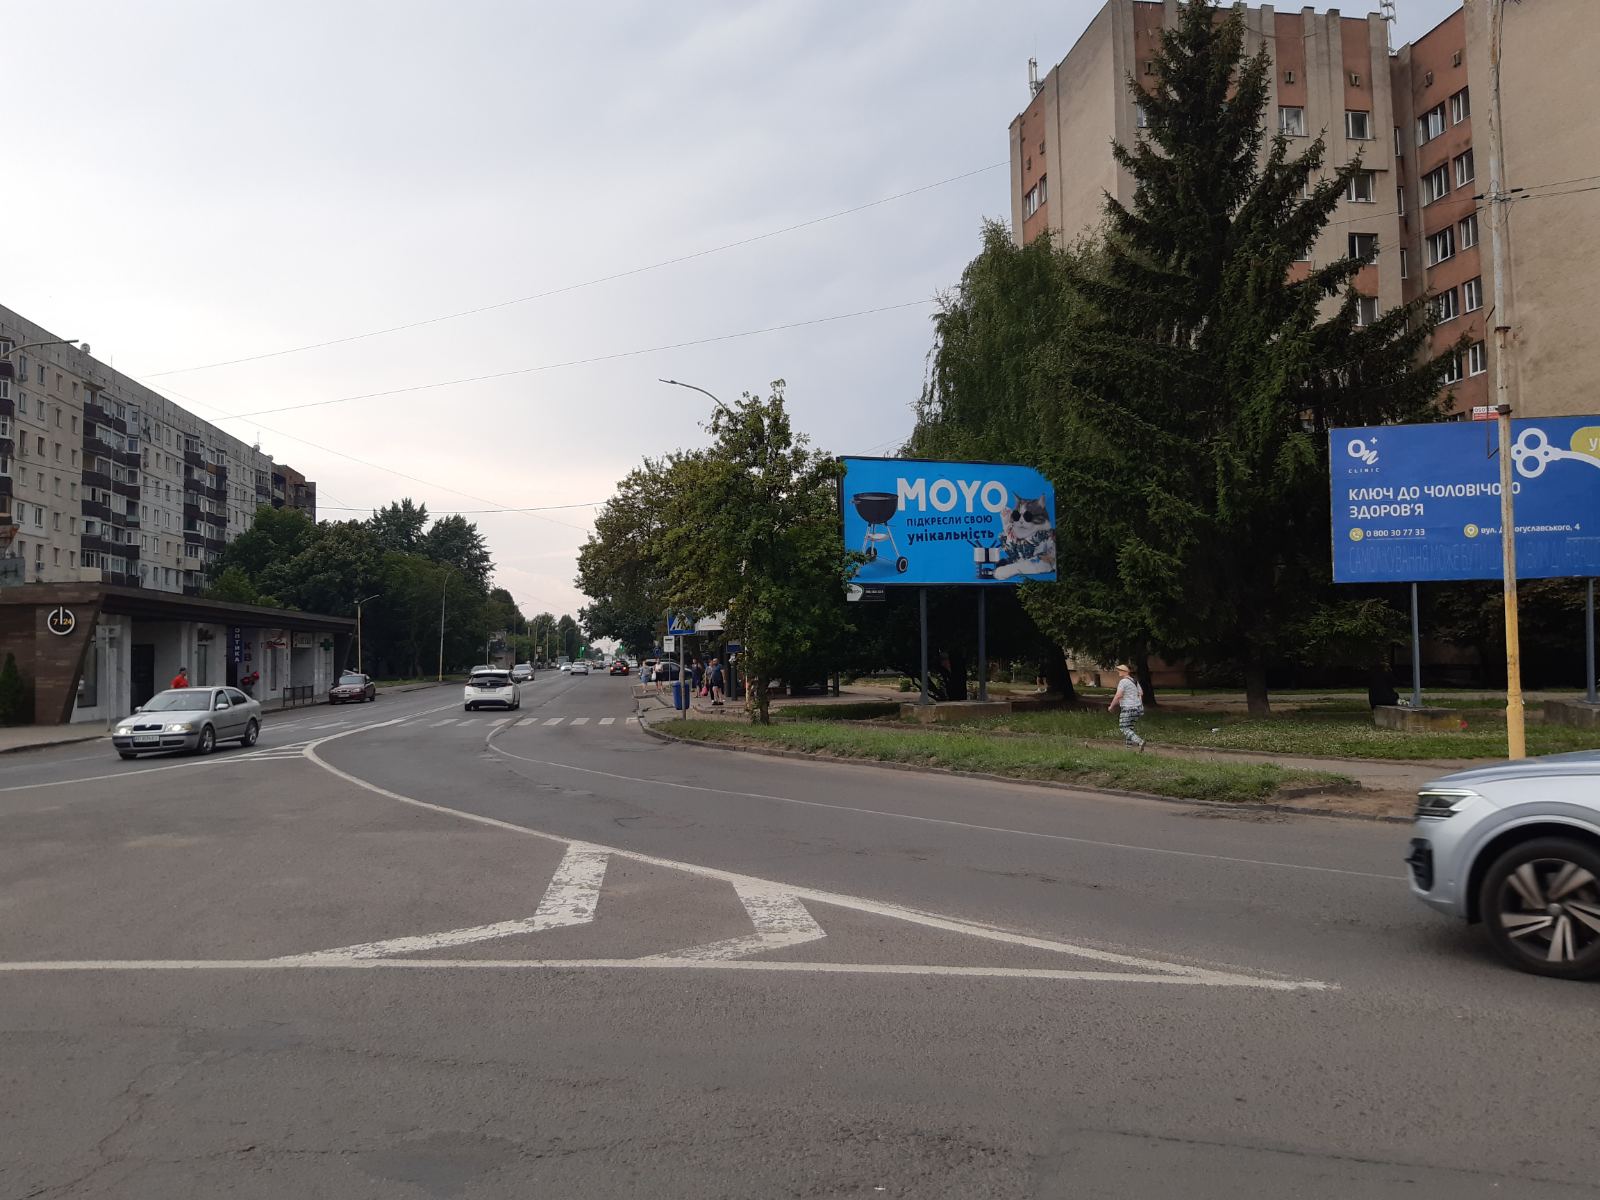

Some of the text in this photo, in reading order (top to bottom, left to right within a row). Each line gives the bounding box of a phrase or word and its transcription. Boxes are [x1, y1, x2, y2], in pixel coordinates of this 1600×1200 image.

[896, 477, 1008, 513] MOYO
[1348, 481, 1521, 501] КЛЮЧ ДО ЧОЛОВІЧОО
[906, 514, 993, 527] ПІДКРЕСЛИ СВОЮ
[907, 527, 995, 546] унікальність
[1373, 529, 1389, 537] 800
[1391, 529, 1401, 537] 30
[1403, 528, 1413, 536] 77
[1415, 528, 1425, 536] 33
[1481, 527, 1497, 535] вул.
[1514, 525, 1573, 534] огуславського,
[1574, 523, 1581, 531] 4
